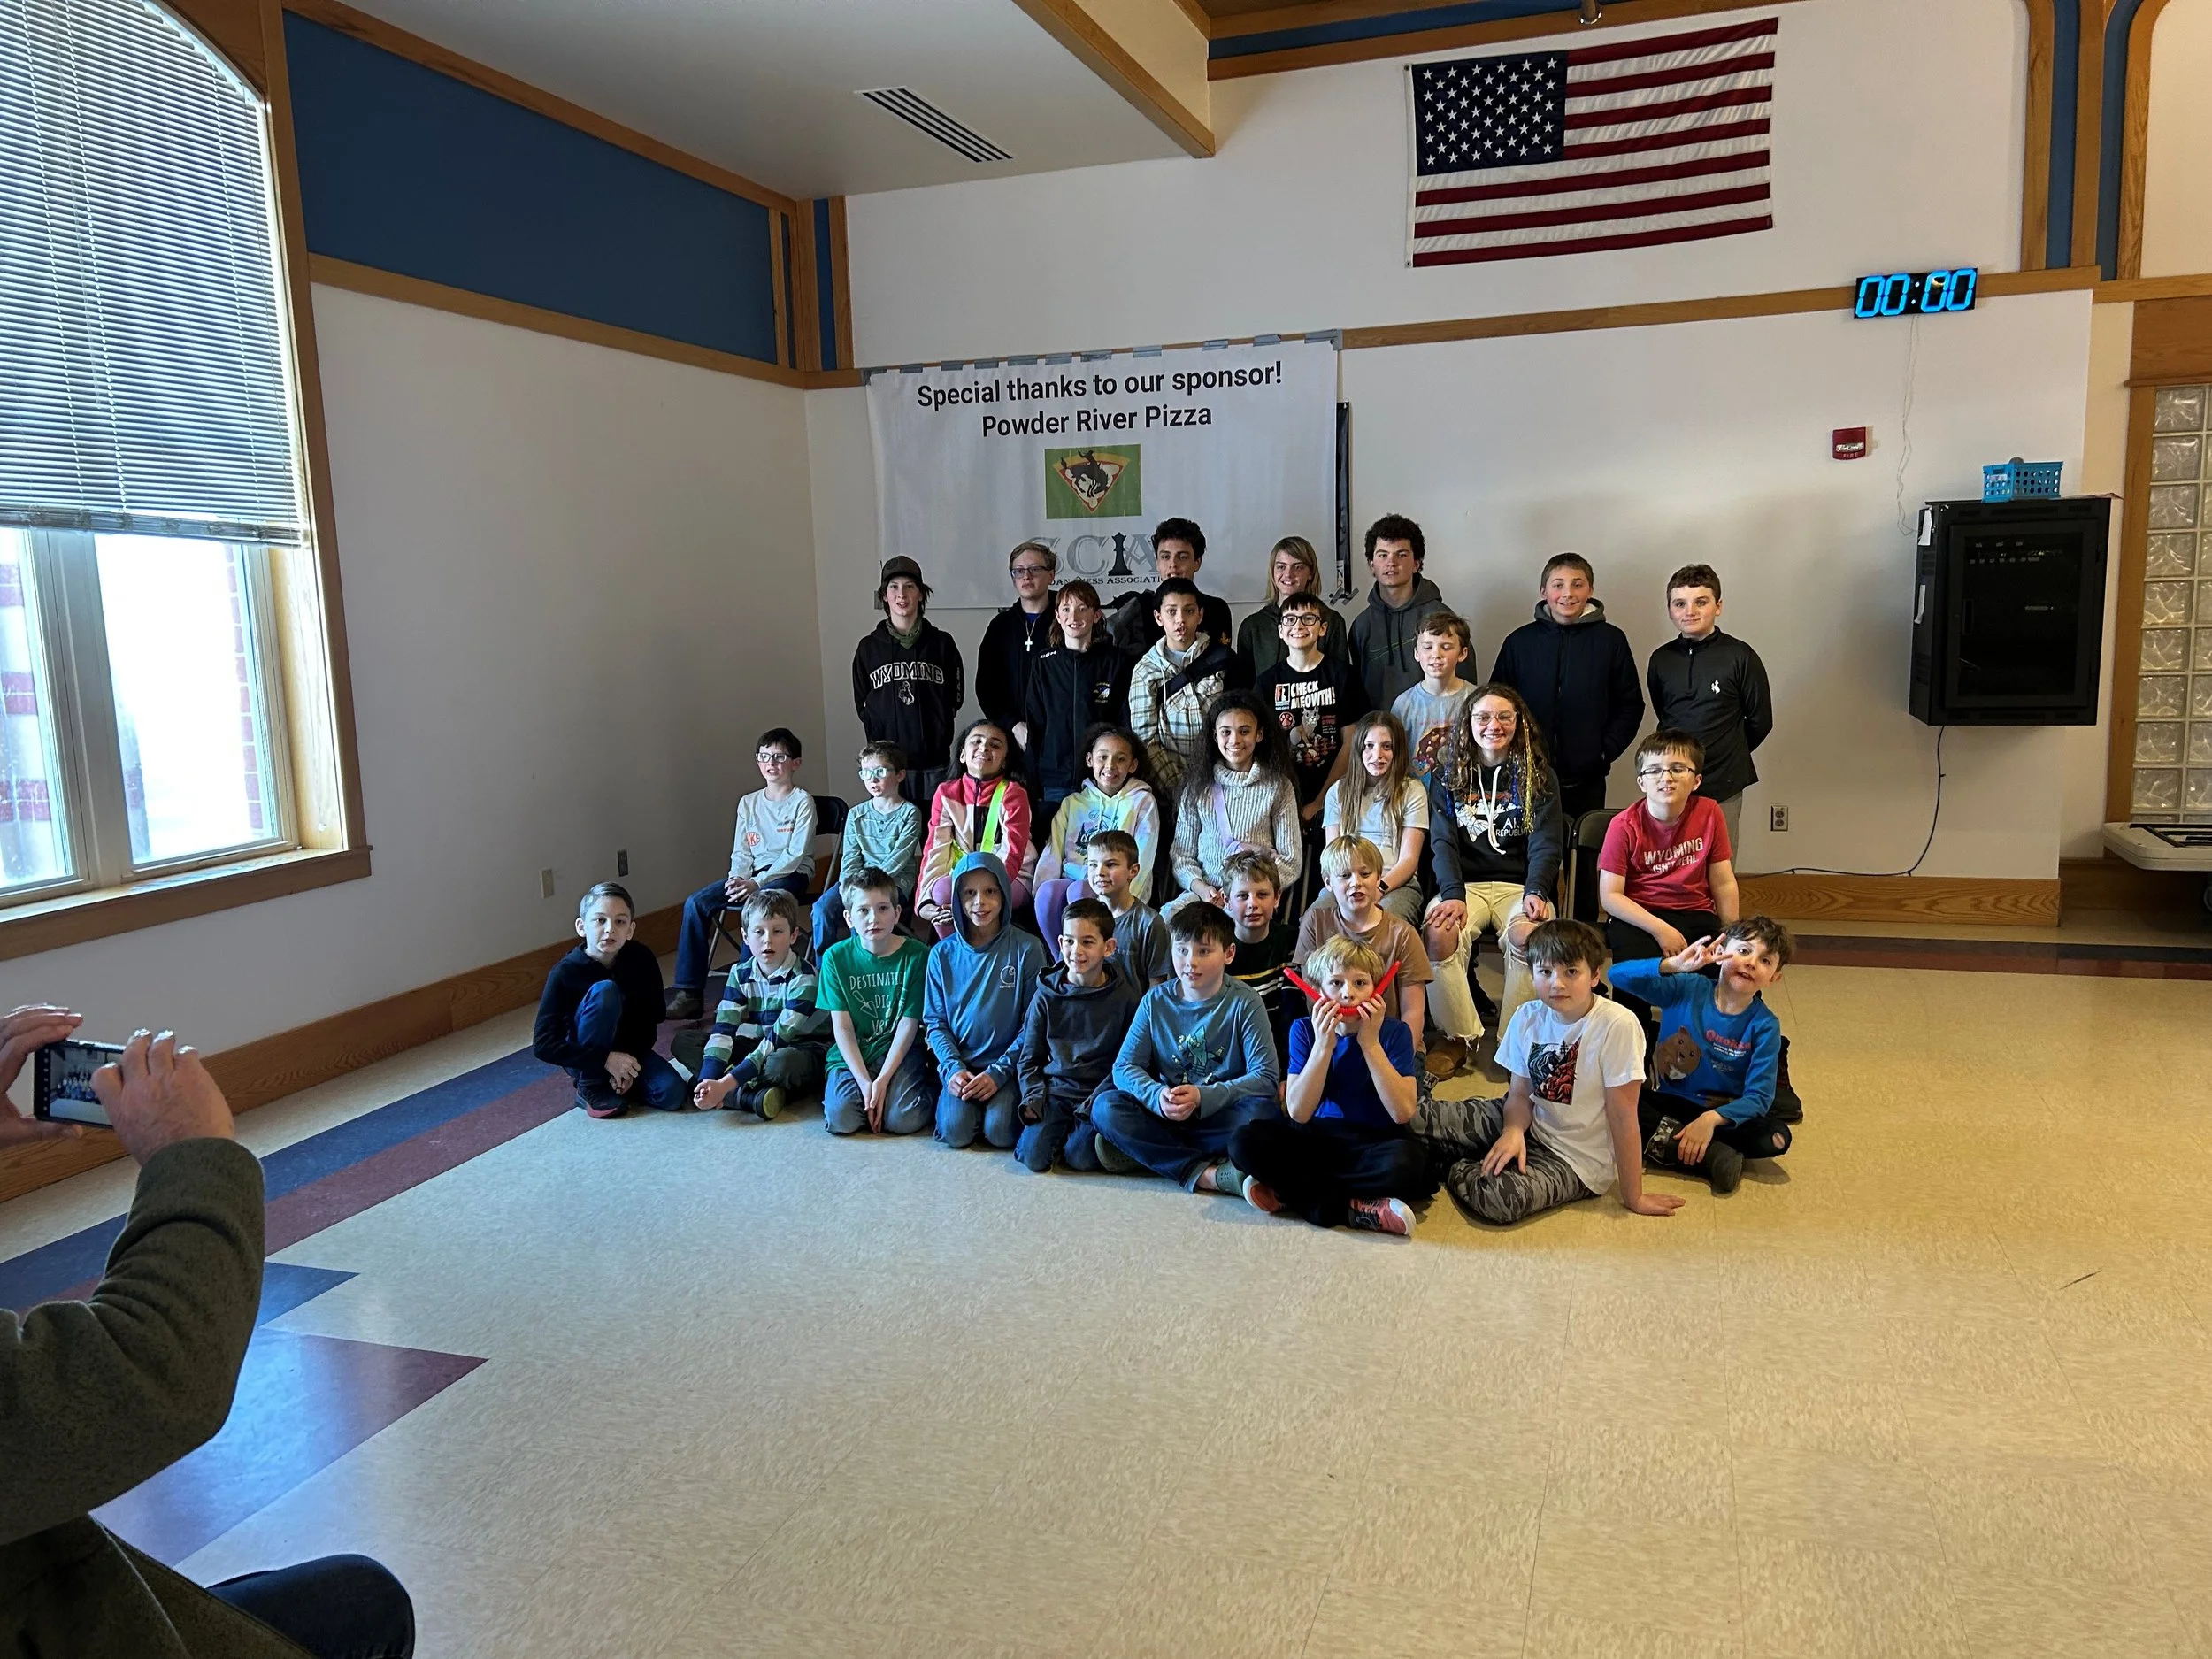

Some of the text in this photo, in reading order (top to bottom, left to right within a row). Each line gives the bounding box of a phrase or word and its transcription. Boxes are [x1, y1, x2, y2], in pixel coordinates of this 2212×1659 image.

[1855, 268, 1977, 318] 00:00
[918, 360, 1282, 411] Special thanks to our sponsor!
[982, 403, 1212, 437] Powder River Pizza
[870, 661, 944, 689] WYOMING
[1291, 680, 1319, 697] CHECK
[1291, 686, 1335, 710] MEOWTH!
[1644, 837, 1703, 865] WYOMING
[849, 972, 902, 990] DESTINATIO
